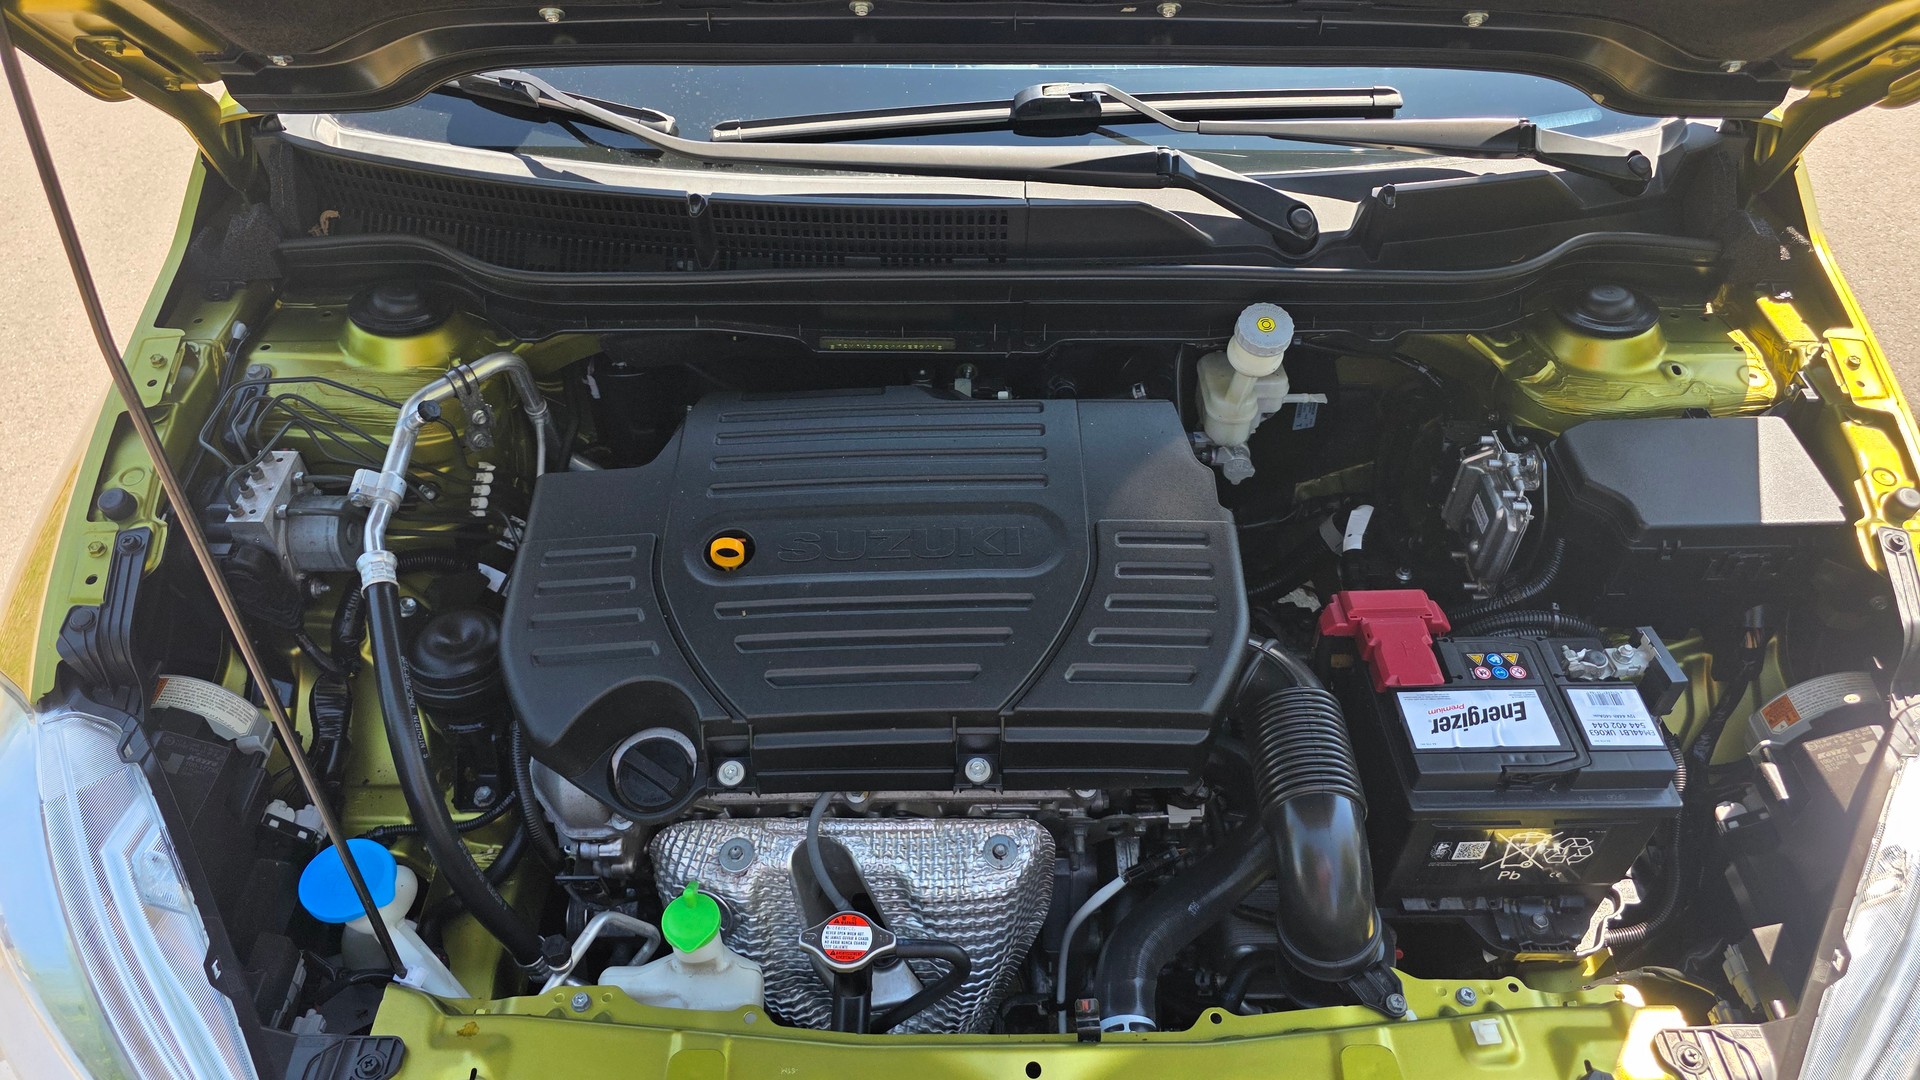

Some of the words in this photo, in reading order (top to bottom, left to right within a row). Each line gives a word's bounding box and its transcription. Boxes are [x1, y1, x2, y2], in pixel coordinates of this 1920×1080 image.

[777, 526, 1022, 562] SUZUKI
[1427, 704, 1465, 715] Premium
[1431, 701, 1527, 735] Energizer
[1497, 871, 1521, 880] Pb
